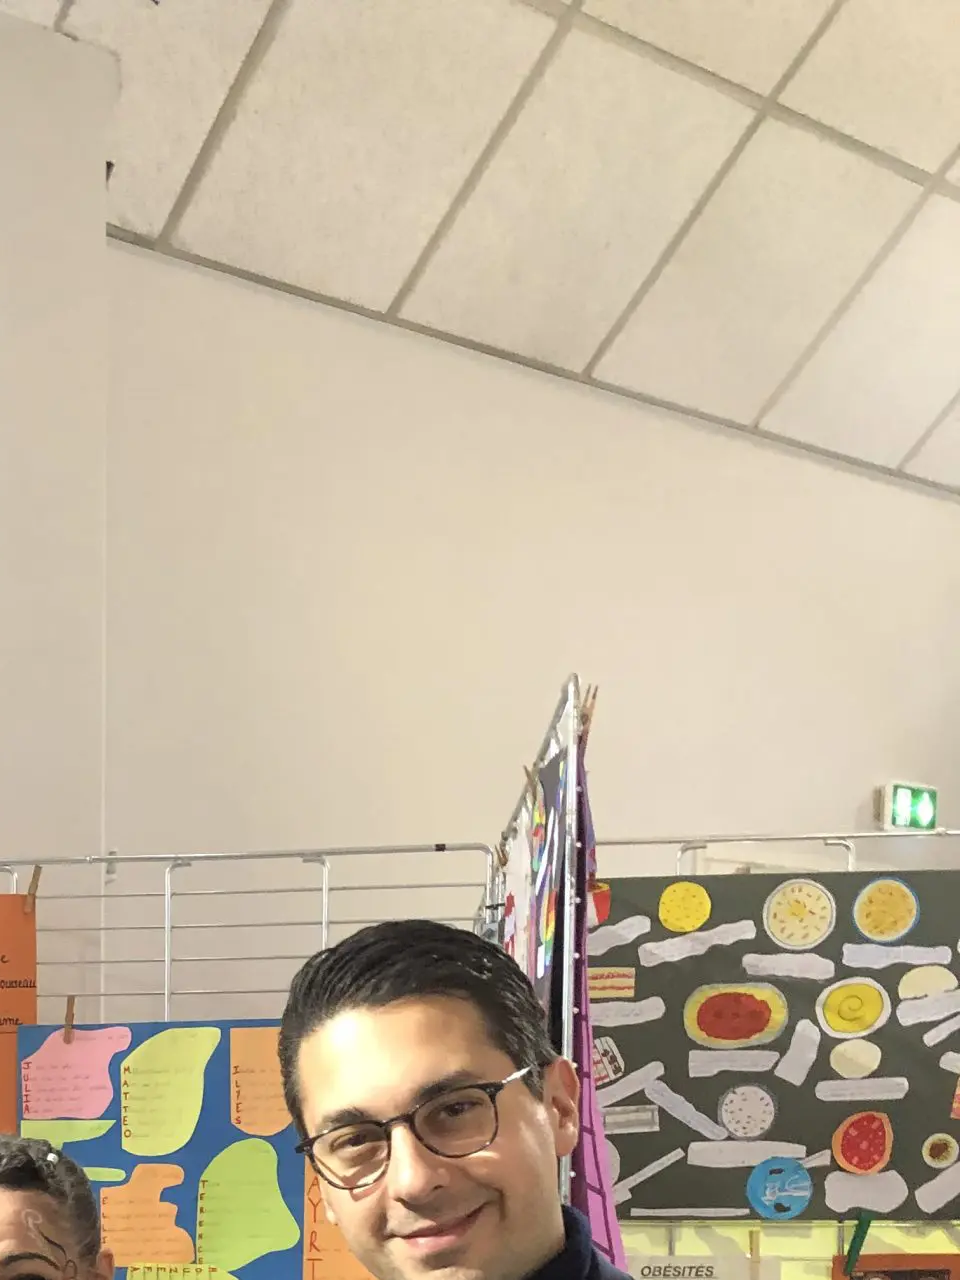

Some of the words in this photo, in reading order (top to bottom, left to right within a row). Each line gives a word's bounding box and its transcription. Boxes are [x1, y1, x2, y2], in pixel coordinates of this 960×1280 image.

[22, 1061, 33, 1114] JULIA
[122, 1065, 132, 1138] MATTEO
[640, 1263, 716, 1278] OBÉSITÉS
